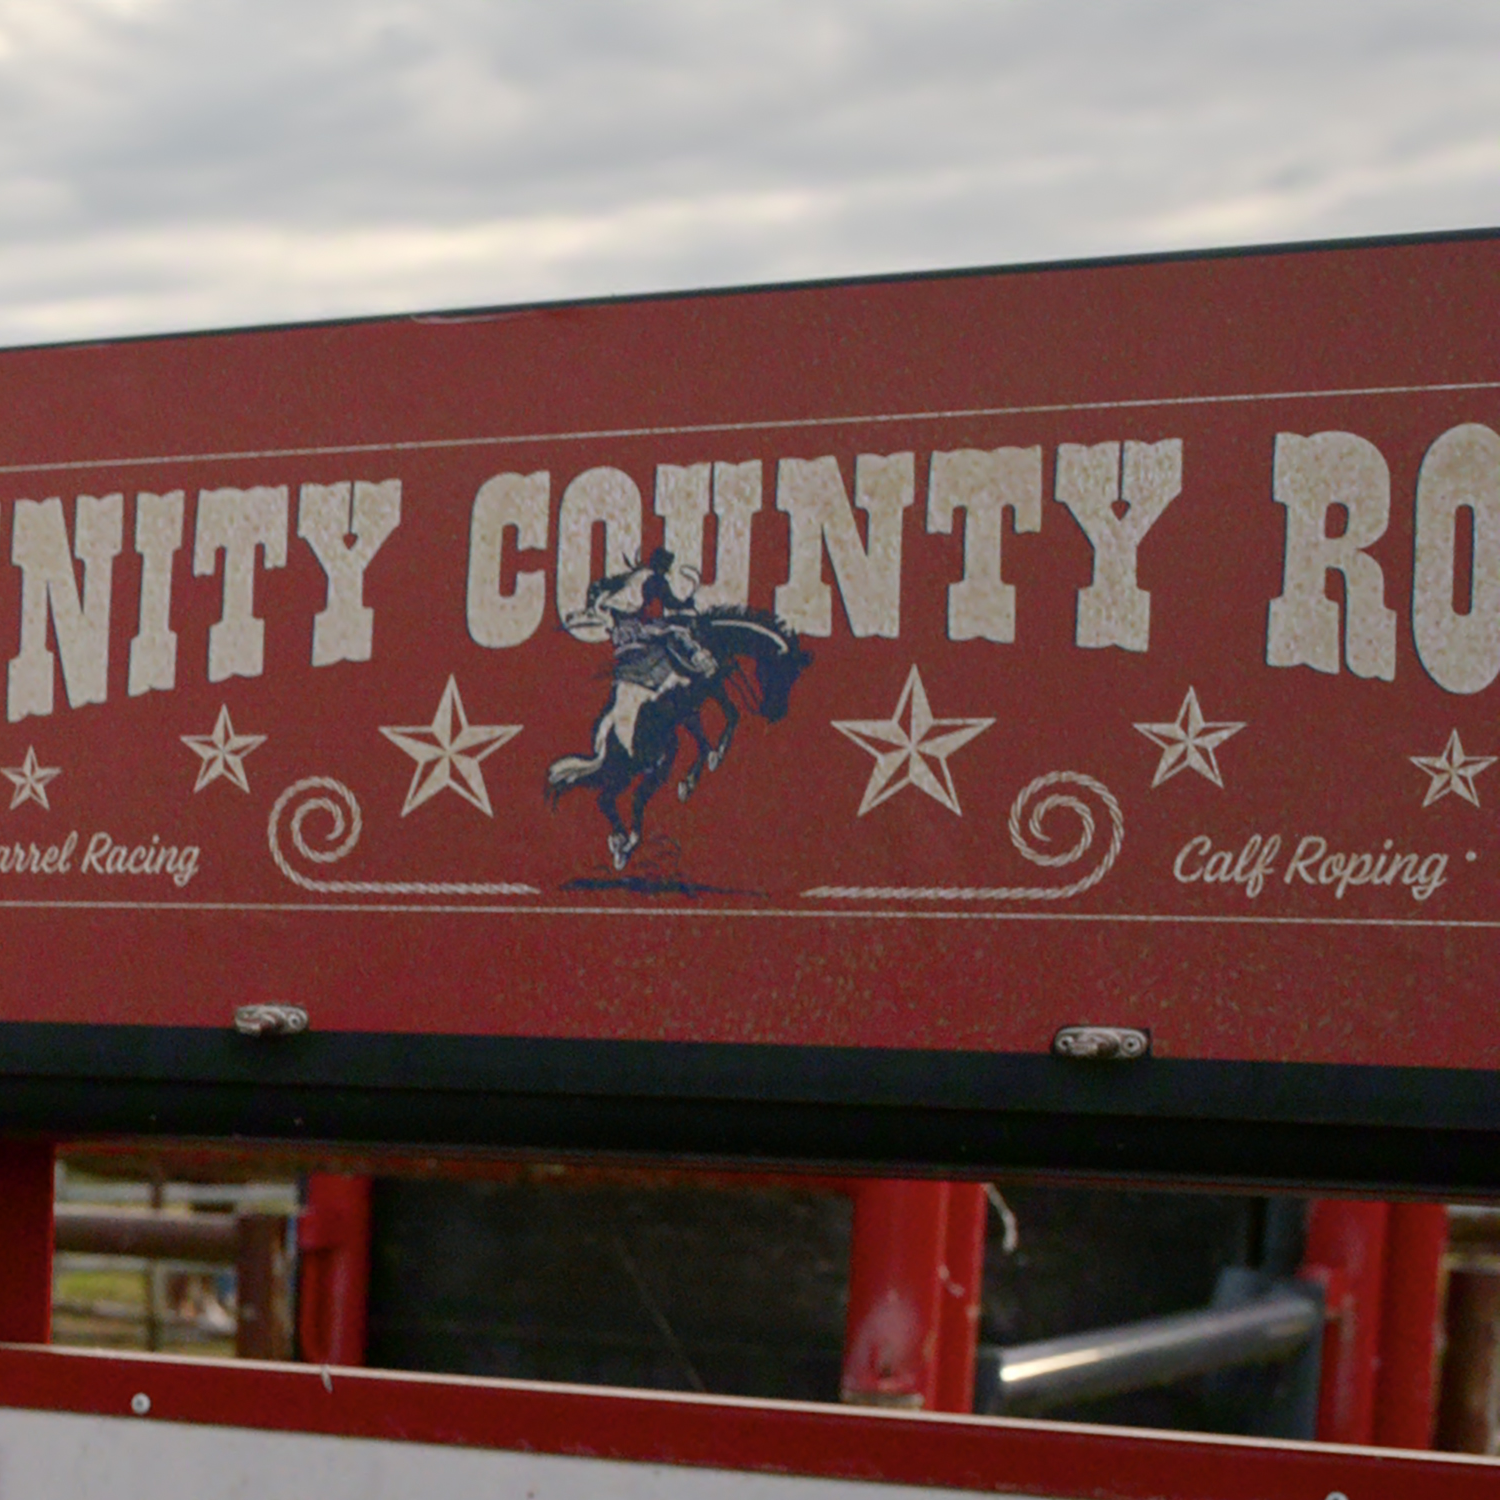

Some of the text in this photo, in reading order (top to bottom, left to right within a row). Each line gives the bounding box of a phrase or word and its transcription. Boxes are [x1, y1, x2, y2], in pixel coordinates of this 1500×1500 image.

[466, 437, 1183, 653] COUNTY
[80, 831, 201, 887] Racing
[1172, 834, 1449, 901] Calf Roping
